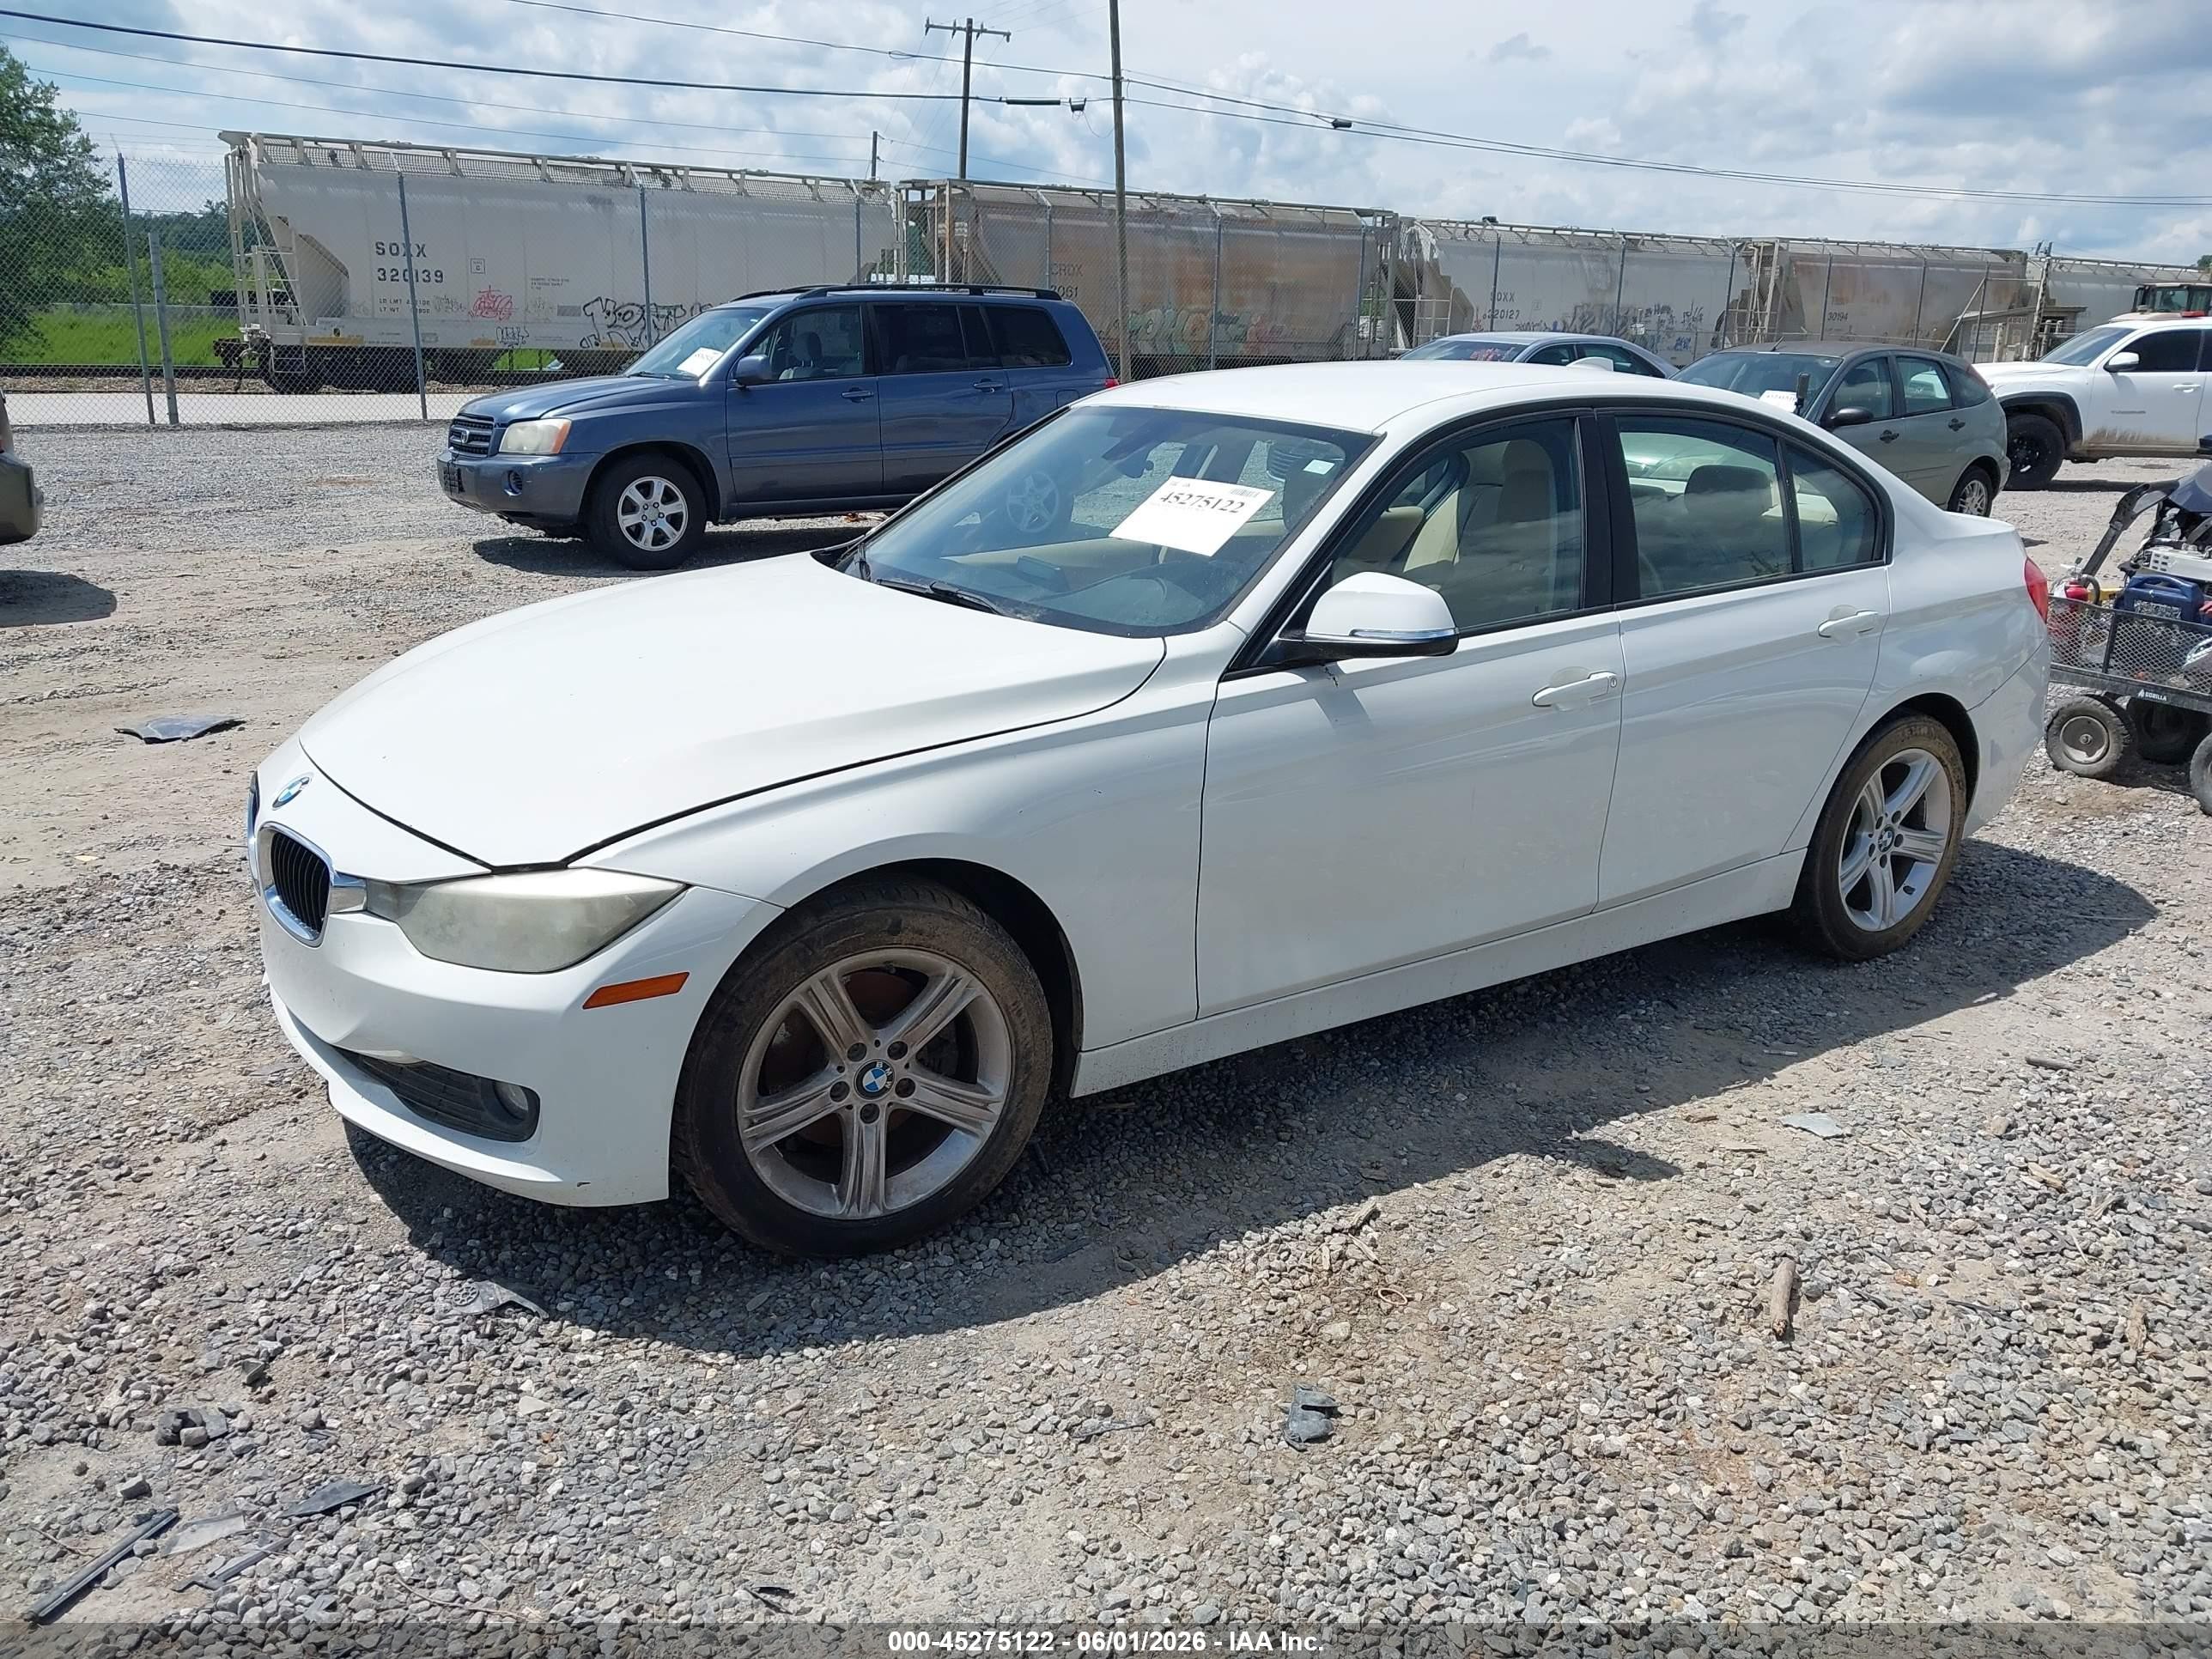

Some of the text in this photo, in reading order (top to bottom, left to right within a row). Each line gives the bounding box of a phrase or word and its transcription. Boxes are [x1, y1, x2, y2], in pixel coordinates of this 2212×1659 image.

[375, 240, 428, 258] SOXX
[377, 267, 445, 284] 320139
[1160, 491, 1246, 514] 45275122
